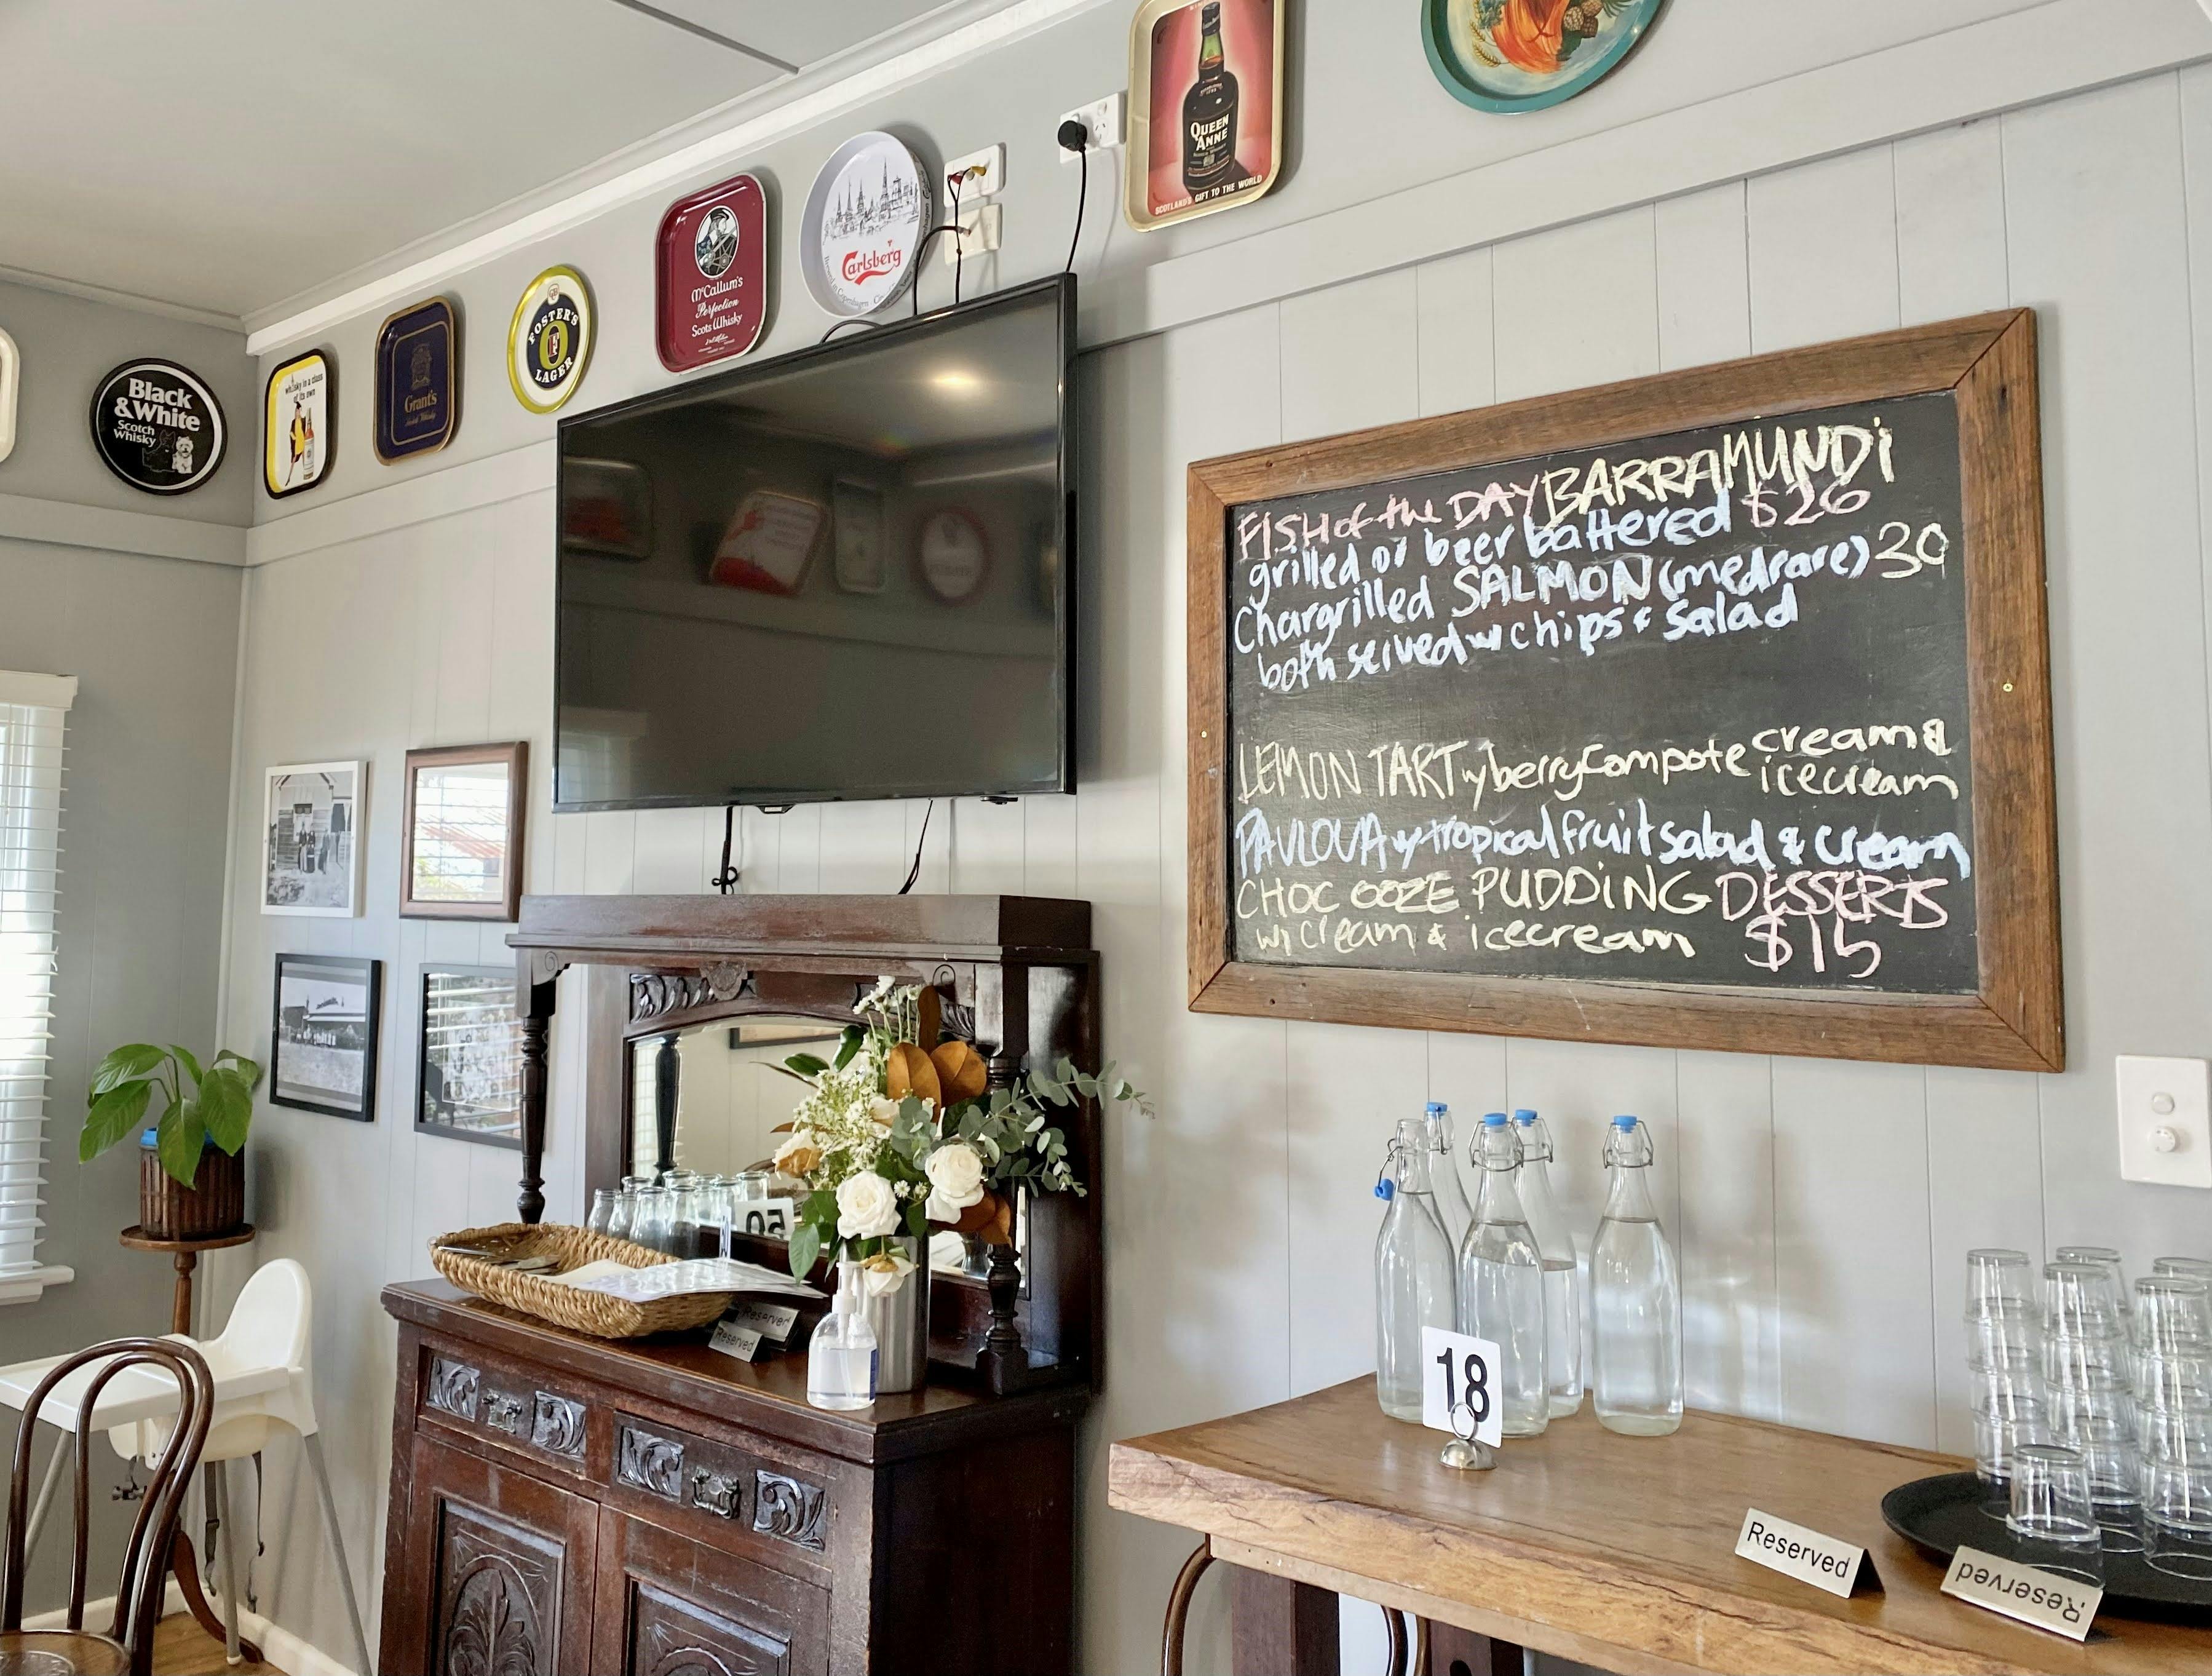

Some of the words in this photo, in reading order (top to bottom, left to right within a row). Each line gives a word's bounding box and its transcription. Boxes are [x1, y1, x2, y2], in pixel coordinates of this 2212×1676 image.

[1191, 113, 1229, 141] QUEEN
[1196, 127, 1229, 151] ANNE
[1155, 197, 1192, 215] SCOTLAND'S
[1195, 191, 1209, 202] GIFT
[1211, 188, 1220, 197] TO
[1223, 183, 1235, 194] THE
[1238, 175, 1263, 189] WORLD
[842, 249, 902, 285] Carlsberg
[528, 308, 579, 345] FOSTER'S
[692, 324, 712, 338] Scots
[713, 311, 743, 330] Whisky
[695, 298, 740, 319] Perfection
[534, 356, 573, 383] LAGER
[129, 378, 192, 409] Black
[405, 389, 437, 413] Grant's
[114, 429, 156, 447] Whisky
[117, 420, 154, 435] Scotch
[1237, 510, 1330, 561] FISH
[1446, 474, 1539, 530] DAY
[1250, 543, 1361, 609] grilled
[1424, 523, 1515, 566] beer
[1524, 487, 1731, 558] battered
[1740, 479, 1871, 528] $26
[1452, 554, 1652, 618] SALMON
[1875, 522, 1949, 575] 30
[1258, 639, 1337, 692] both
[1511, 607, 1625, 657] chips
[1238, 741, 1361, 803] LEMON
[1368, 741, 1469, 799] TART
[1235, 808, 1387, 878] PAVLOVA
[1418, 804, 1560, 865] tropical
[1563, 798, 1655, 857] fruit
[1236, 878, 1339, 918] CHOC
[1351, 871, 1459, 914] OOZE
[1744, 912, 1882, 978] $15
[715, 1327, 756, 1352] Reserved
[1437, 1347, 1489, 1422] 18
[1747, 1521, 1850, 1578] Reserved
[1955, 1563, 2085, 1623] Reserved
